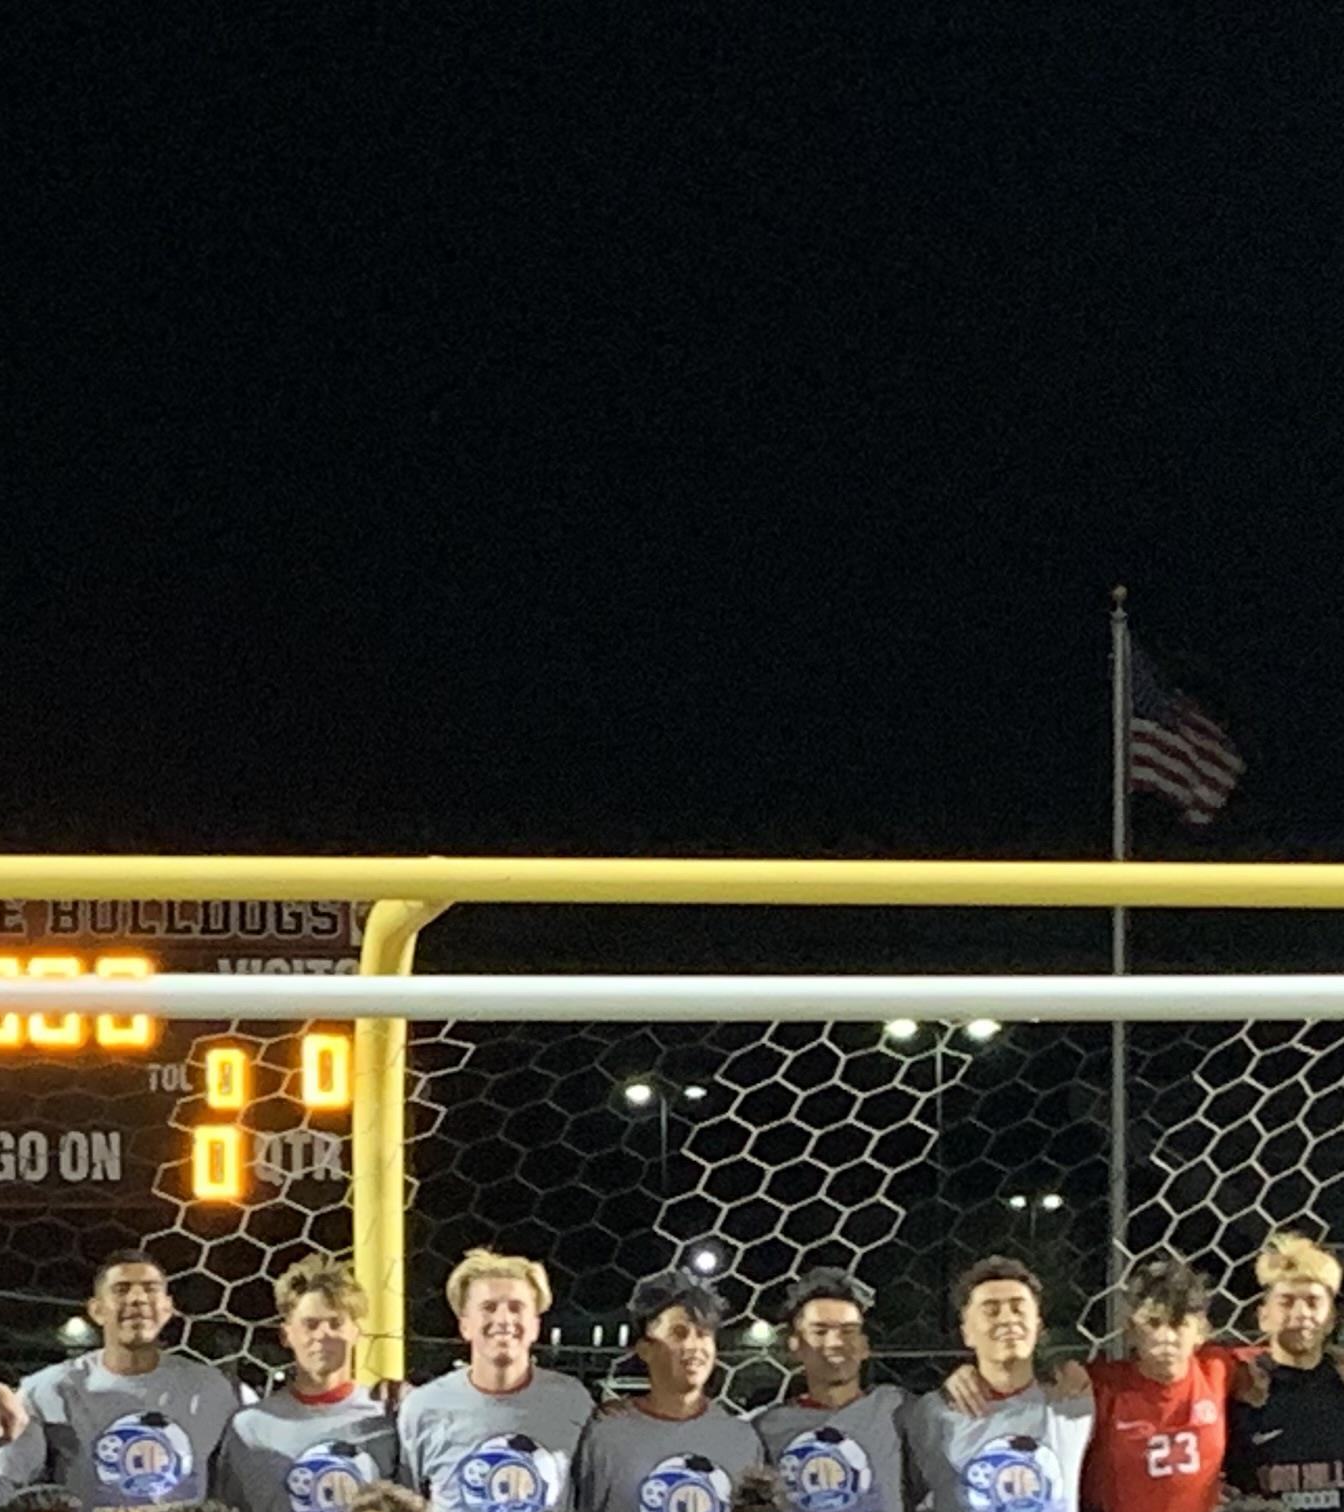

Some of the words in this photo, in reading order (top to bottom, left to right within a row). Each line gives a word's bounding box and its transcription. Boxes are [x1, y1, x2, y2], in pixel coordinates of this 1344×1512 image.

[46, 900, 342, 941] BULLDOGS
[302, 1034, 350, 1106] 0
[59, 1131, 122, 1182] ON
[193, 1126, 240, 1198] 0
[1146, 1431, 1200, 1478] 23
